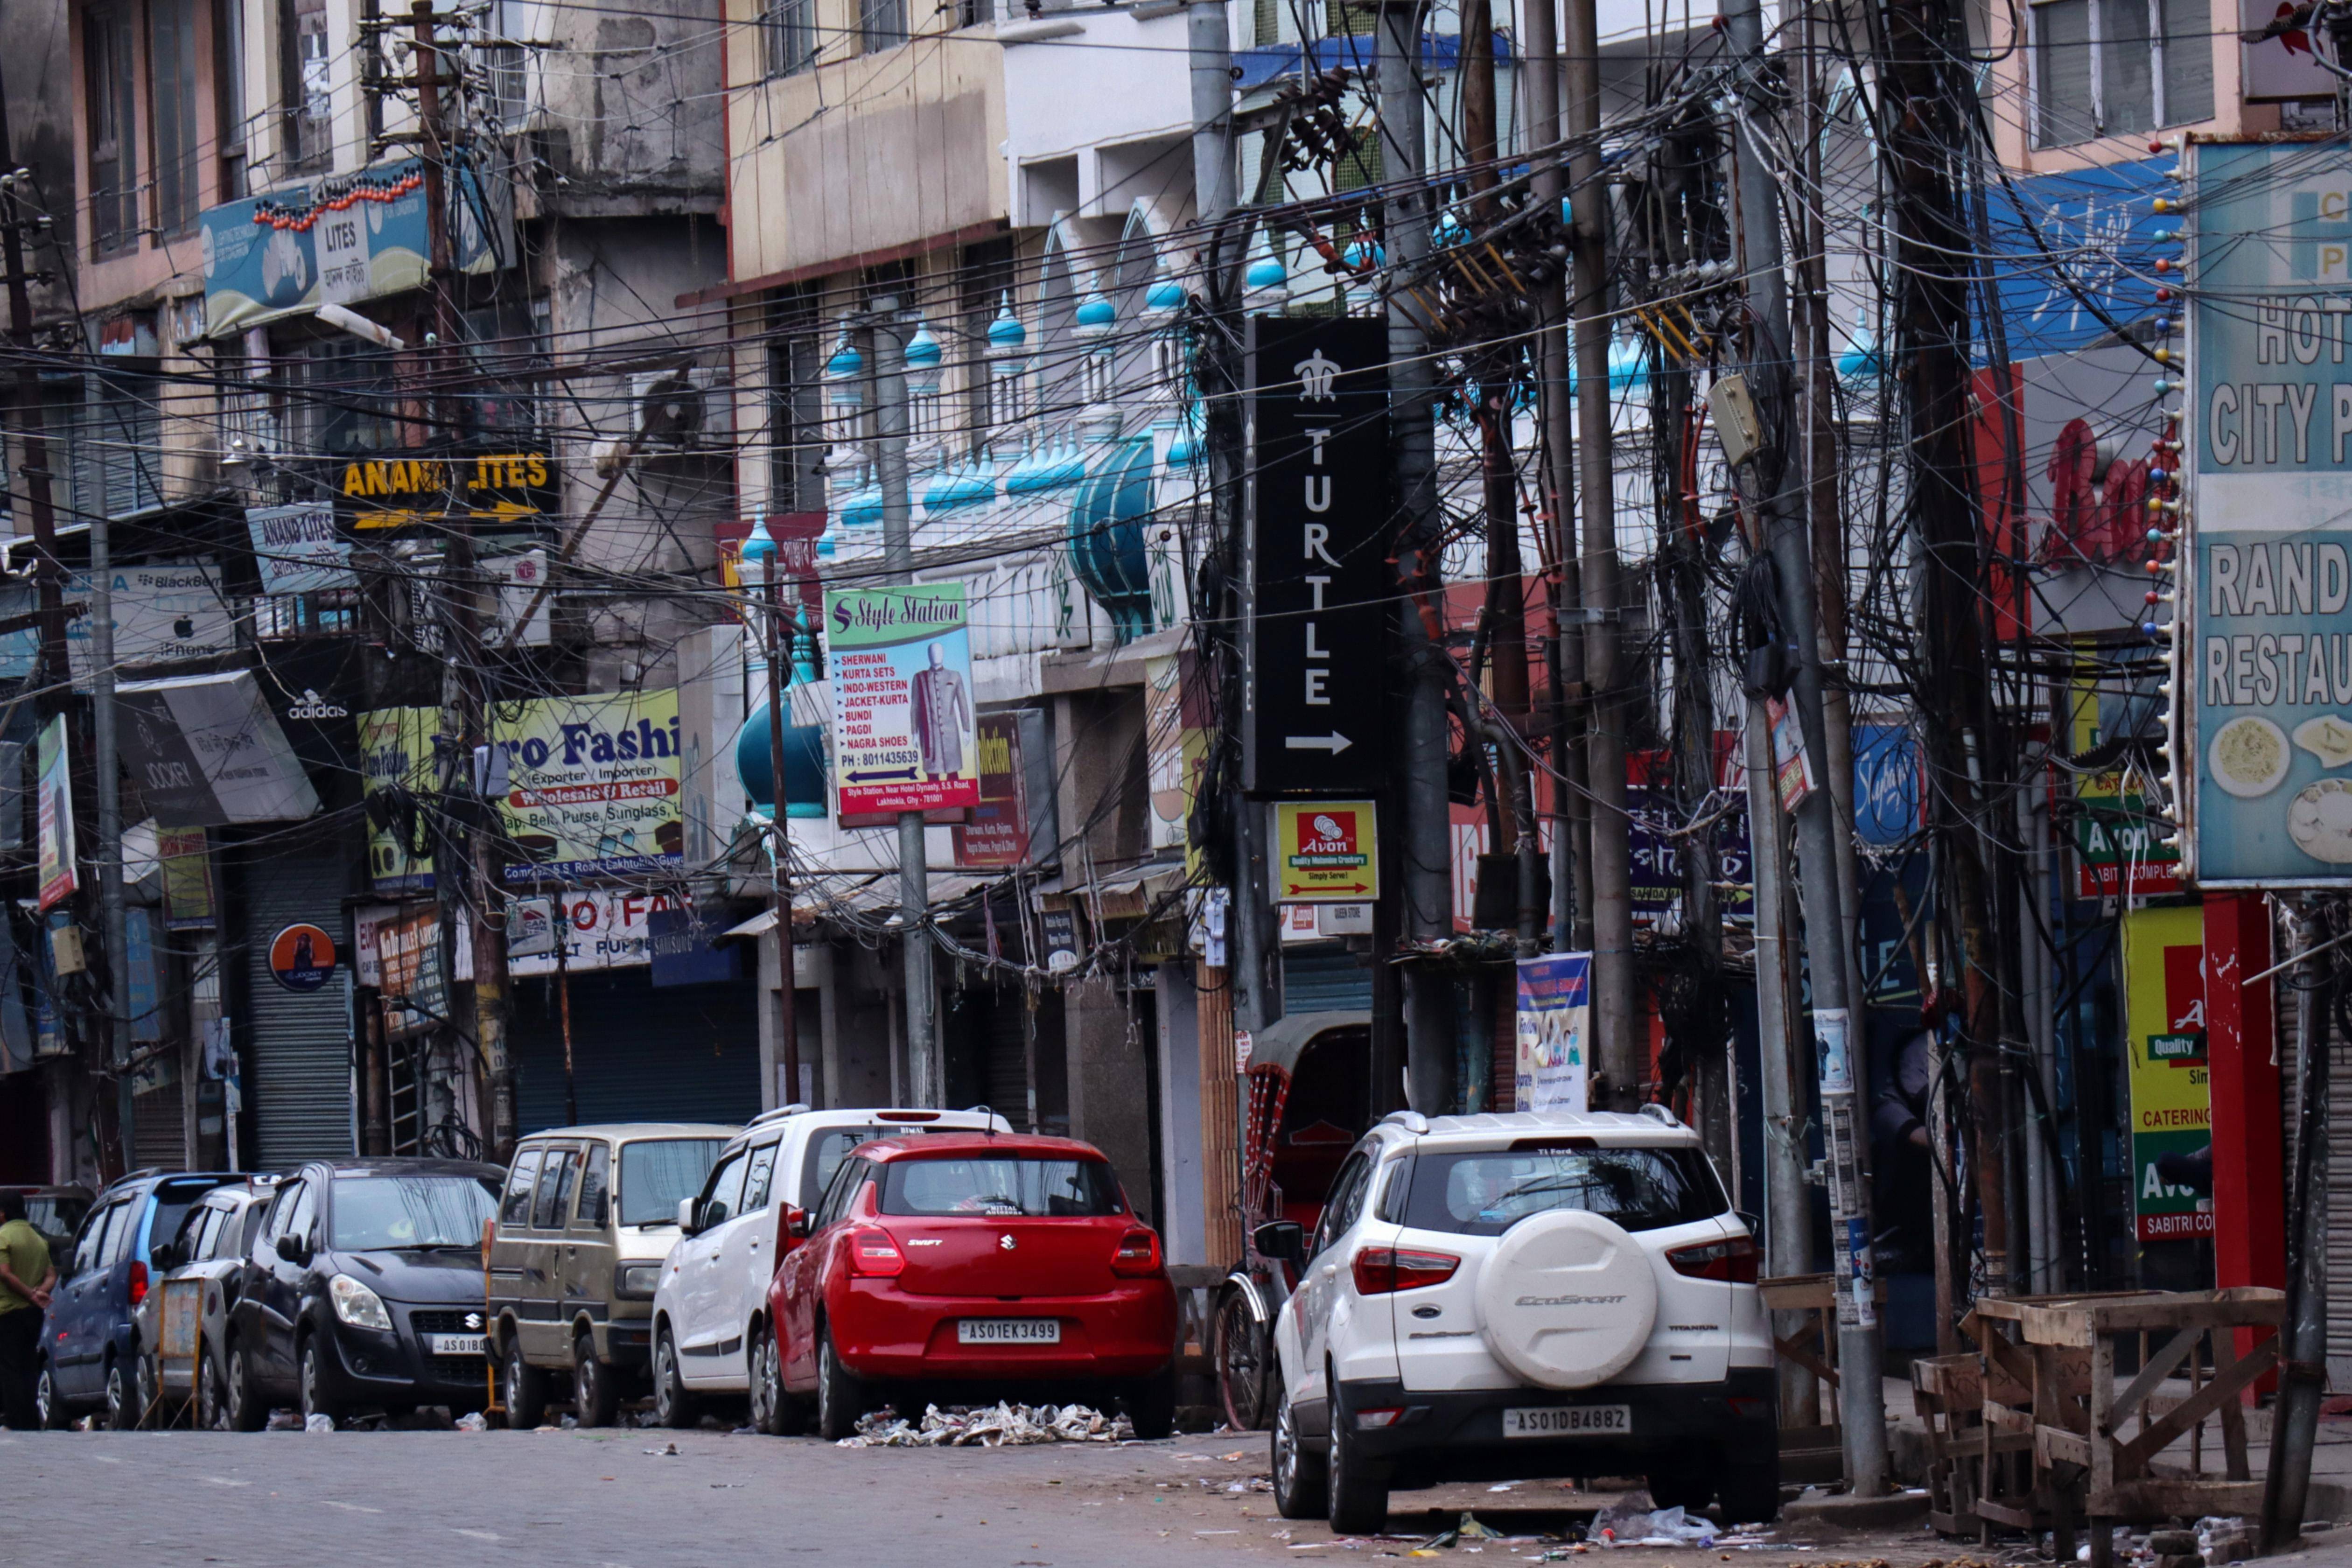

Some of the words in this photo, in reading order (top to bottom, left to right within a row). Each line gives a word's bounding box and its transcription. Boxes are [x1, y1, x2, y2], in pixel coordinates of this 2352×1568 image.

[2322, 192, 2344, 219] C
[330, 221, 363, 255] LITES
[2323, 248, 2343, 274] P
[2257, 296, 2352, 364] HOT
[2210, 383, 2317, 465] CITY
[263, 517, 301, 546] ANAND
[304, 513, 335, 542] LITES
[1305, 429, 1343, 705] TURTLE
[2210, 543, 2350, 616] RAND
[855, 597, 895, 633] Style
[901, 595, 959, 624] Station
[161, 644, 215, 656] iPhone
[841, 653, 886, 666] SHERWANI
[842, 669, 871, 680] KURTA
[874, 666, 895, 678] SETS
[843, 680, 908, 693] INDO-WESTERN
[845, 694, 909, 707] JACKET-KURTA
[288, 703, 348, 719] adidas
[845, 710, 872, 721] BUNDI
[847, 724, 871, 735] PAGDI
[847, 738, 877, 749] NAGRA
[879, 735, 908, 748] SHOES
[841, 755, 854, 767] PH
[863, 750, 918, 766] 8011435639
[146, 761, 193, 789] JOCKEY
[520, 788, 600, 805] Wholesale
[618, 781, 667, 799] Retail
[847, 787, 861, 798] Style
[863, 786, 884, 796] Station,
[900, 784, 916, 792] Hotel
[916, 783, 940, 792] Dynasty,
[954, 780, 971, 789] Road,
[907, 796, 918, 806] Ghy
[506, 818, 526, 832] ap,
[562, 810, 603, 825] Purse,
[607, 798, 671, 822] Sunglass,
[1301, 839, 1347, 853] Avon
[1291, 856, 1310, 865] Quality
[1309, 872, 1328, 881] Simply
[1329, 871, 1348, 880] Serve!
[655, 935, 693, 955] SAMSUNG
[2155, 1038, 2193, 1057] Quality
[2148, 1216, 2192, 1233] SABITRI
[969, 1323, 1055, 1339] AS01EK3499
[1519, 1410, 1624, 1430] AS01DB4882
